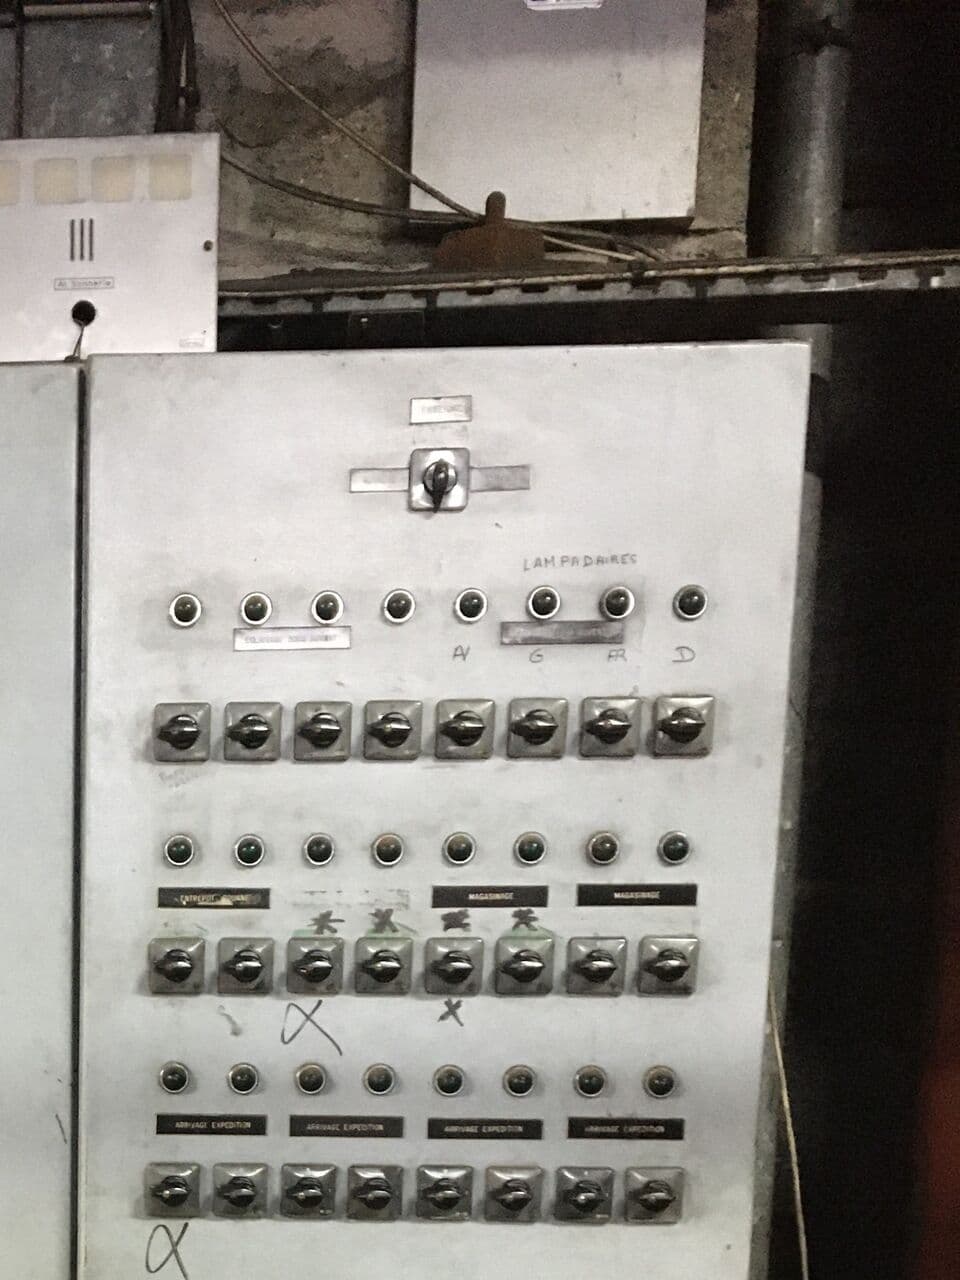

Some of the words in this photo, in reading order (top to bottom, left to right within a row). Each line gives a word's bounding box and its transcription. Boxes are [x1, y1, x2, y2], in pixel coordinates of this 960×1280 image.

[523, 553, 638, 571] LAMPADAIRES
[528, 647, 544, 664] G
[672, 646, 696, 662] D
